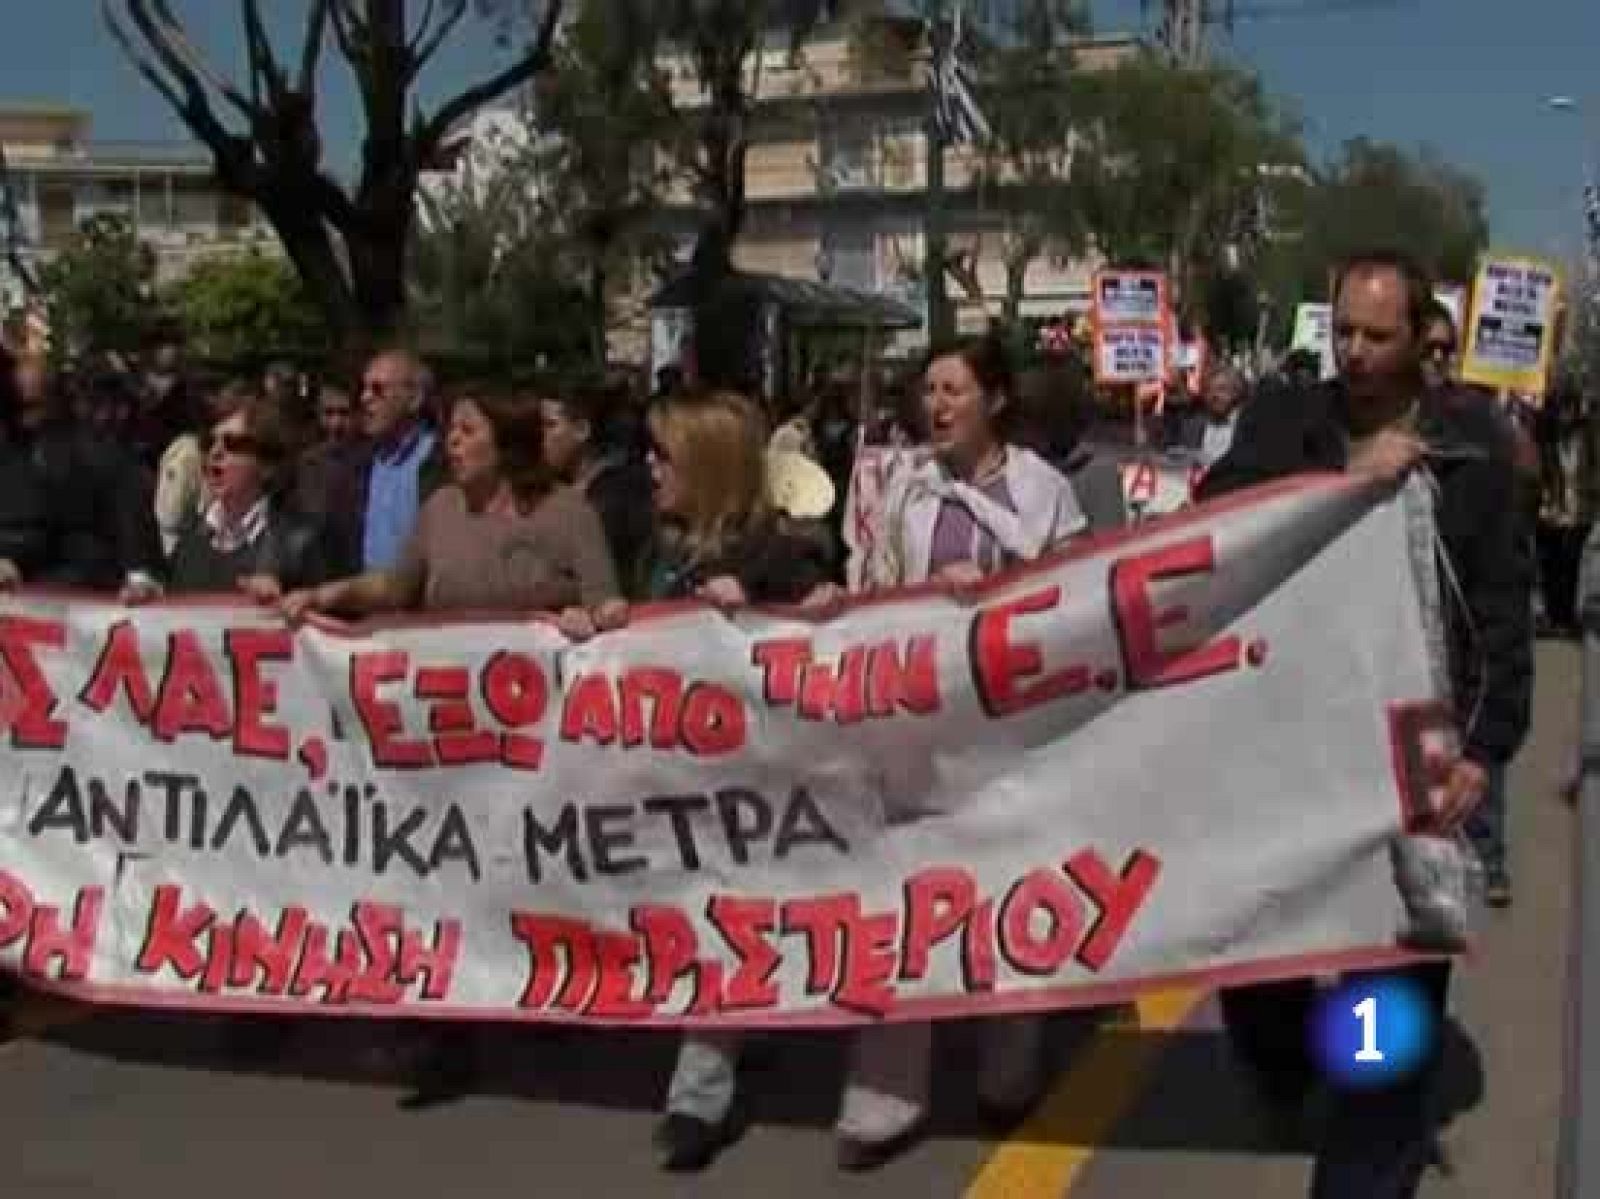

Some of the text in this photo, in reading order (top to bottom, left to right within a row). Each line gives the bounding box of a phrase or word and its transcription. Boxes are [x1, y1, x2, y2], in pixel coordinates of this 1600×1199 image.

[350, 651, 548, 771] ΕΞΩ
[560, 667, 746, 757] ΑΠΟ
[753, 634, 941, 724] ΤΗΝ
[969, 536, 1268, 719] Ε.Ε.
[522, 786, 849, 884] ΜΕΤΡΑ
[135, 884, 464, 1002] ΚΙΝΗΣΗ
[512, 846, 1161, 1018] ΠΕΡΙΣΤΕΡΙΟΥ
